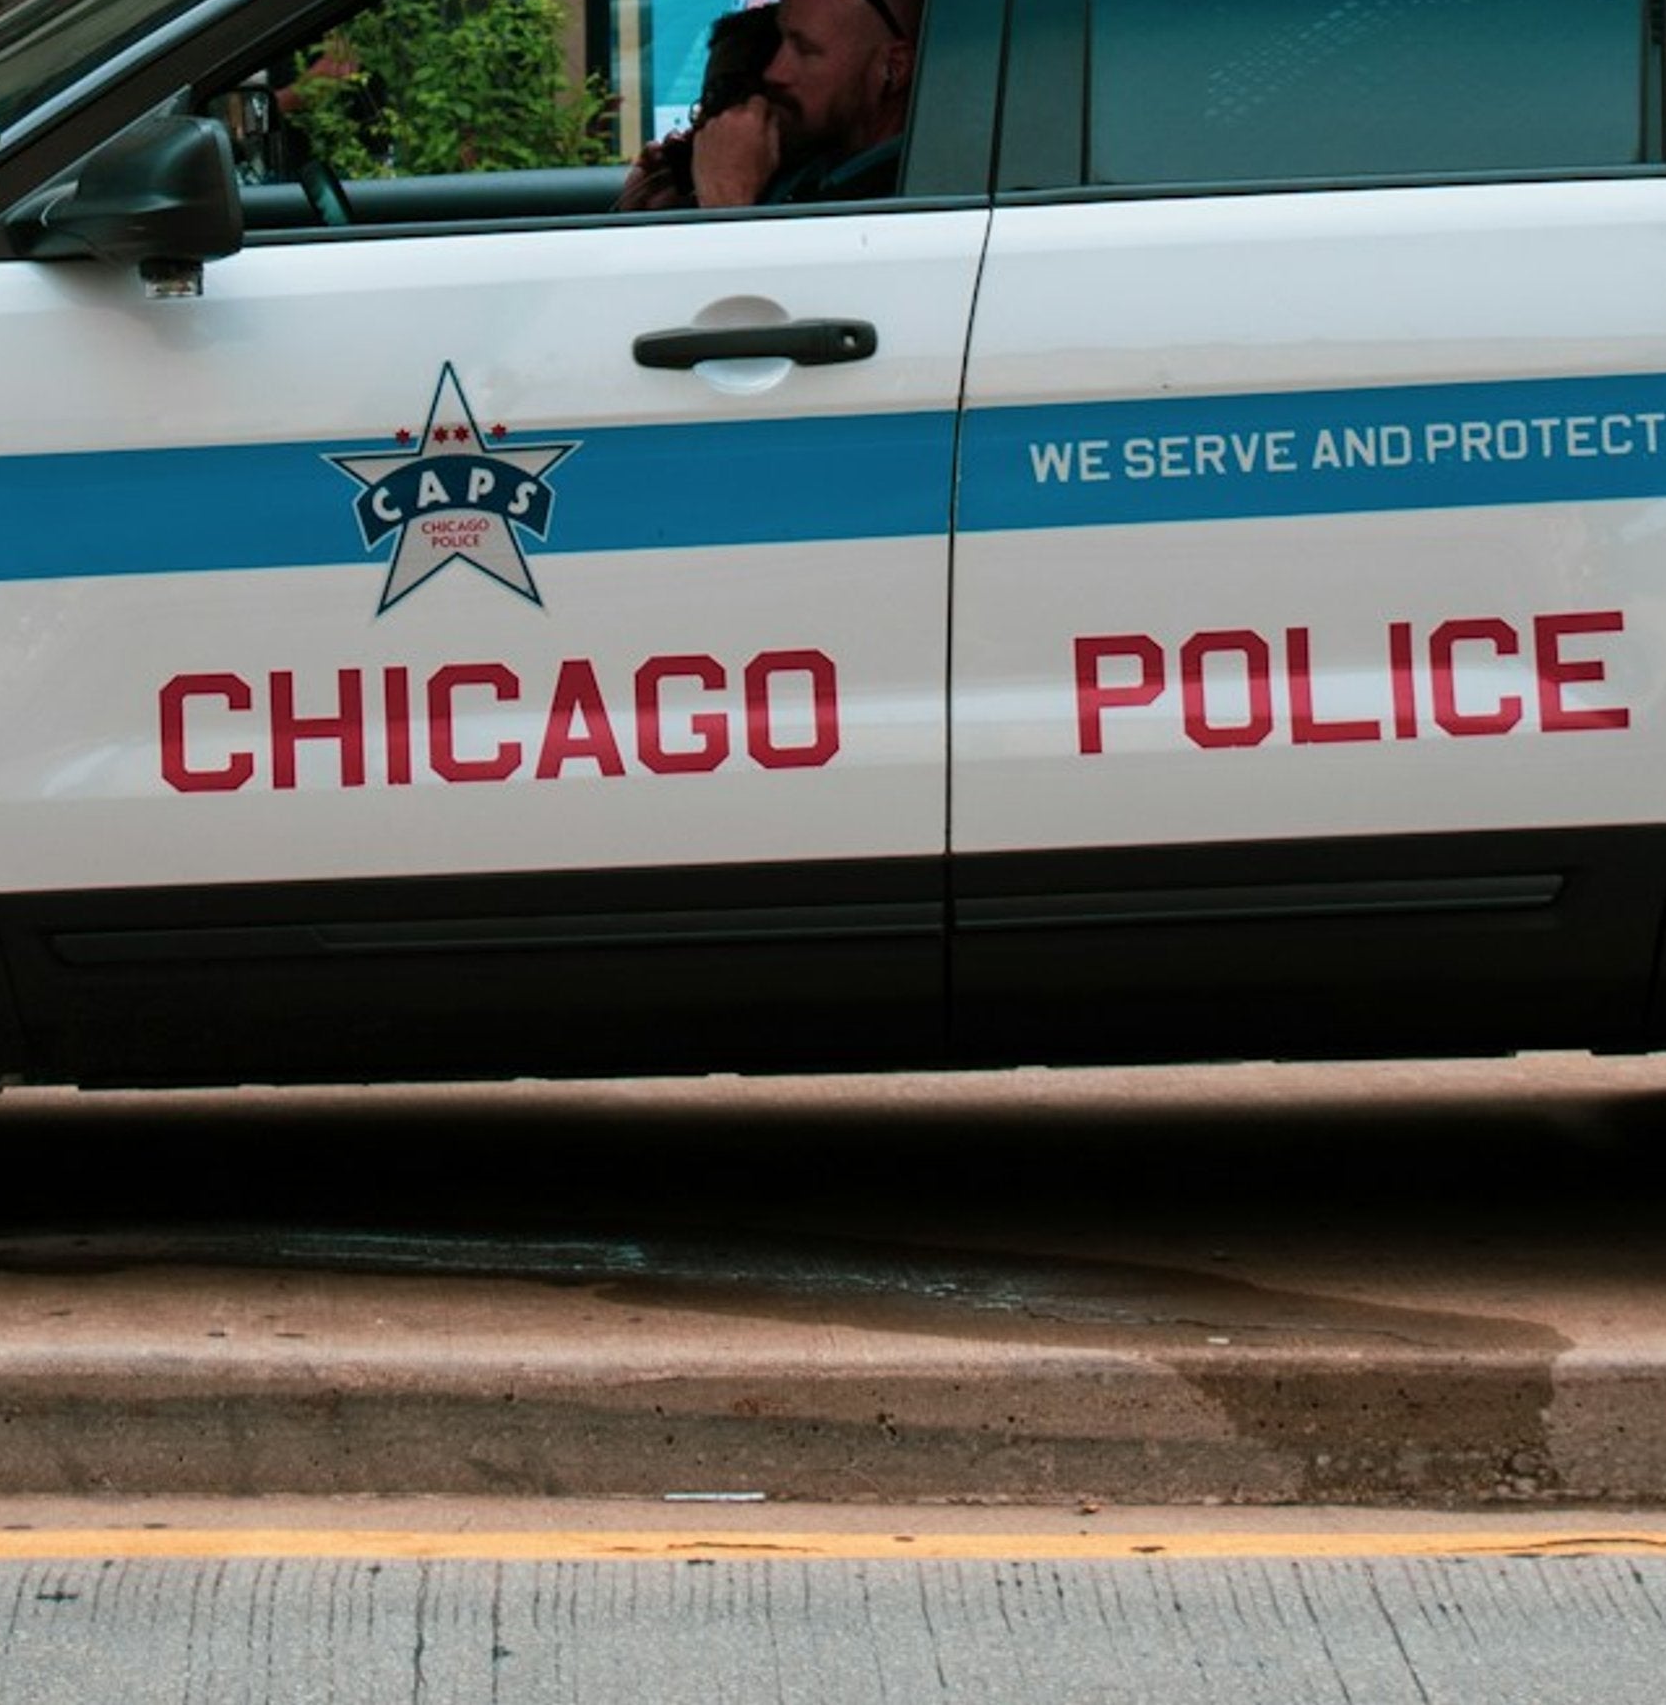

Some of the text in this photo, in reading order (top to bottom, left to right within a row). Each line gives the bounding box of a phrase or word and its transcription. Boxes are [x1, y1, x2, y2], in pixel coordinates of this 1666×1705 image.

[1029, 412, 1666, 485] WE SERVE AND PROTECT
[371, 466, 539, 522] CAPS
[420, 517, 491, 536] CHICAGO
[431, 533, 481, 549] POLICE
[159, 611, 1630, 793] CHICAGO POLICE
